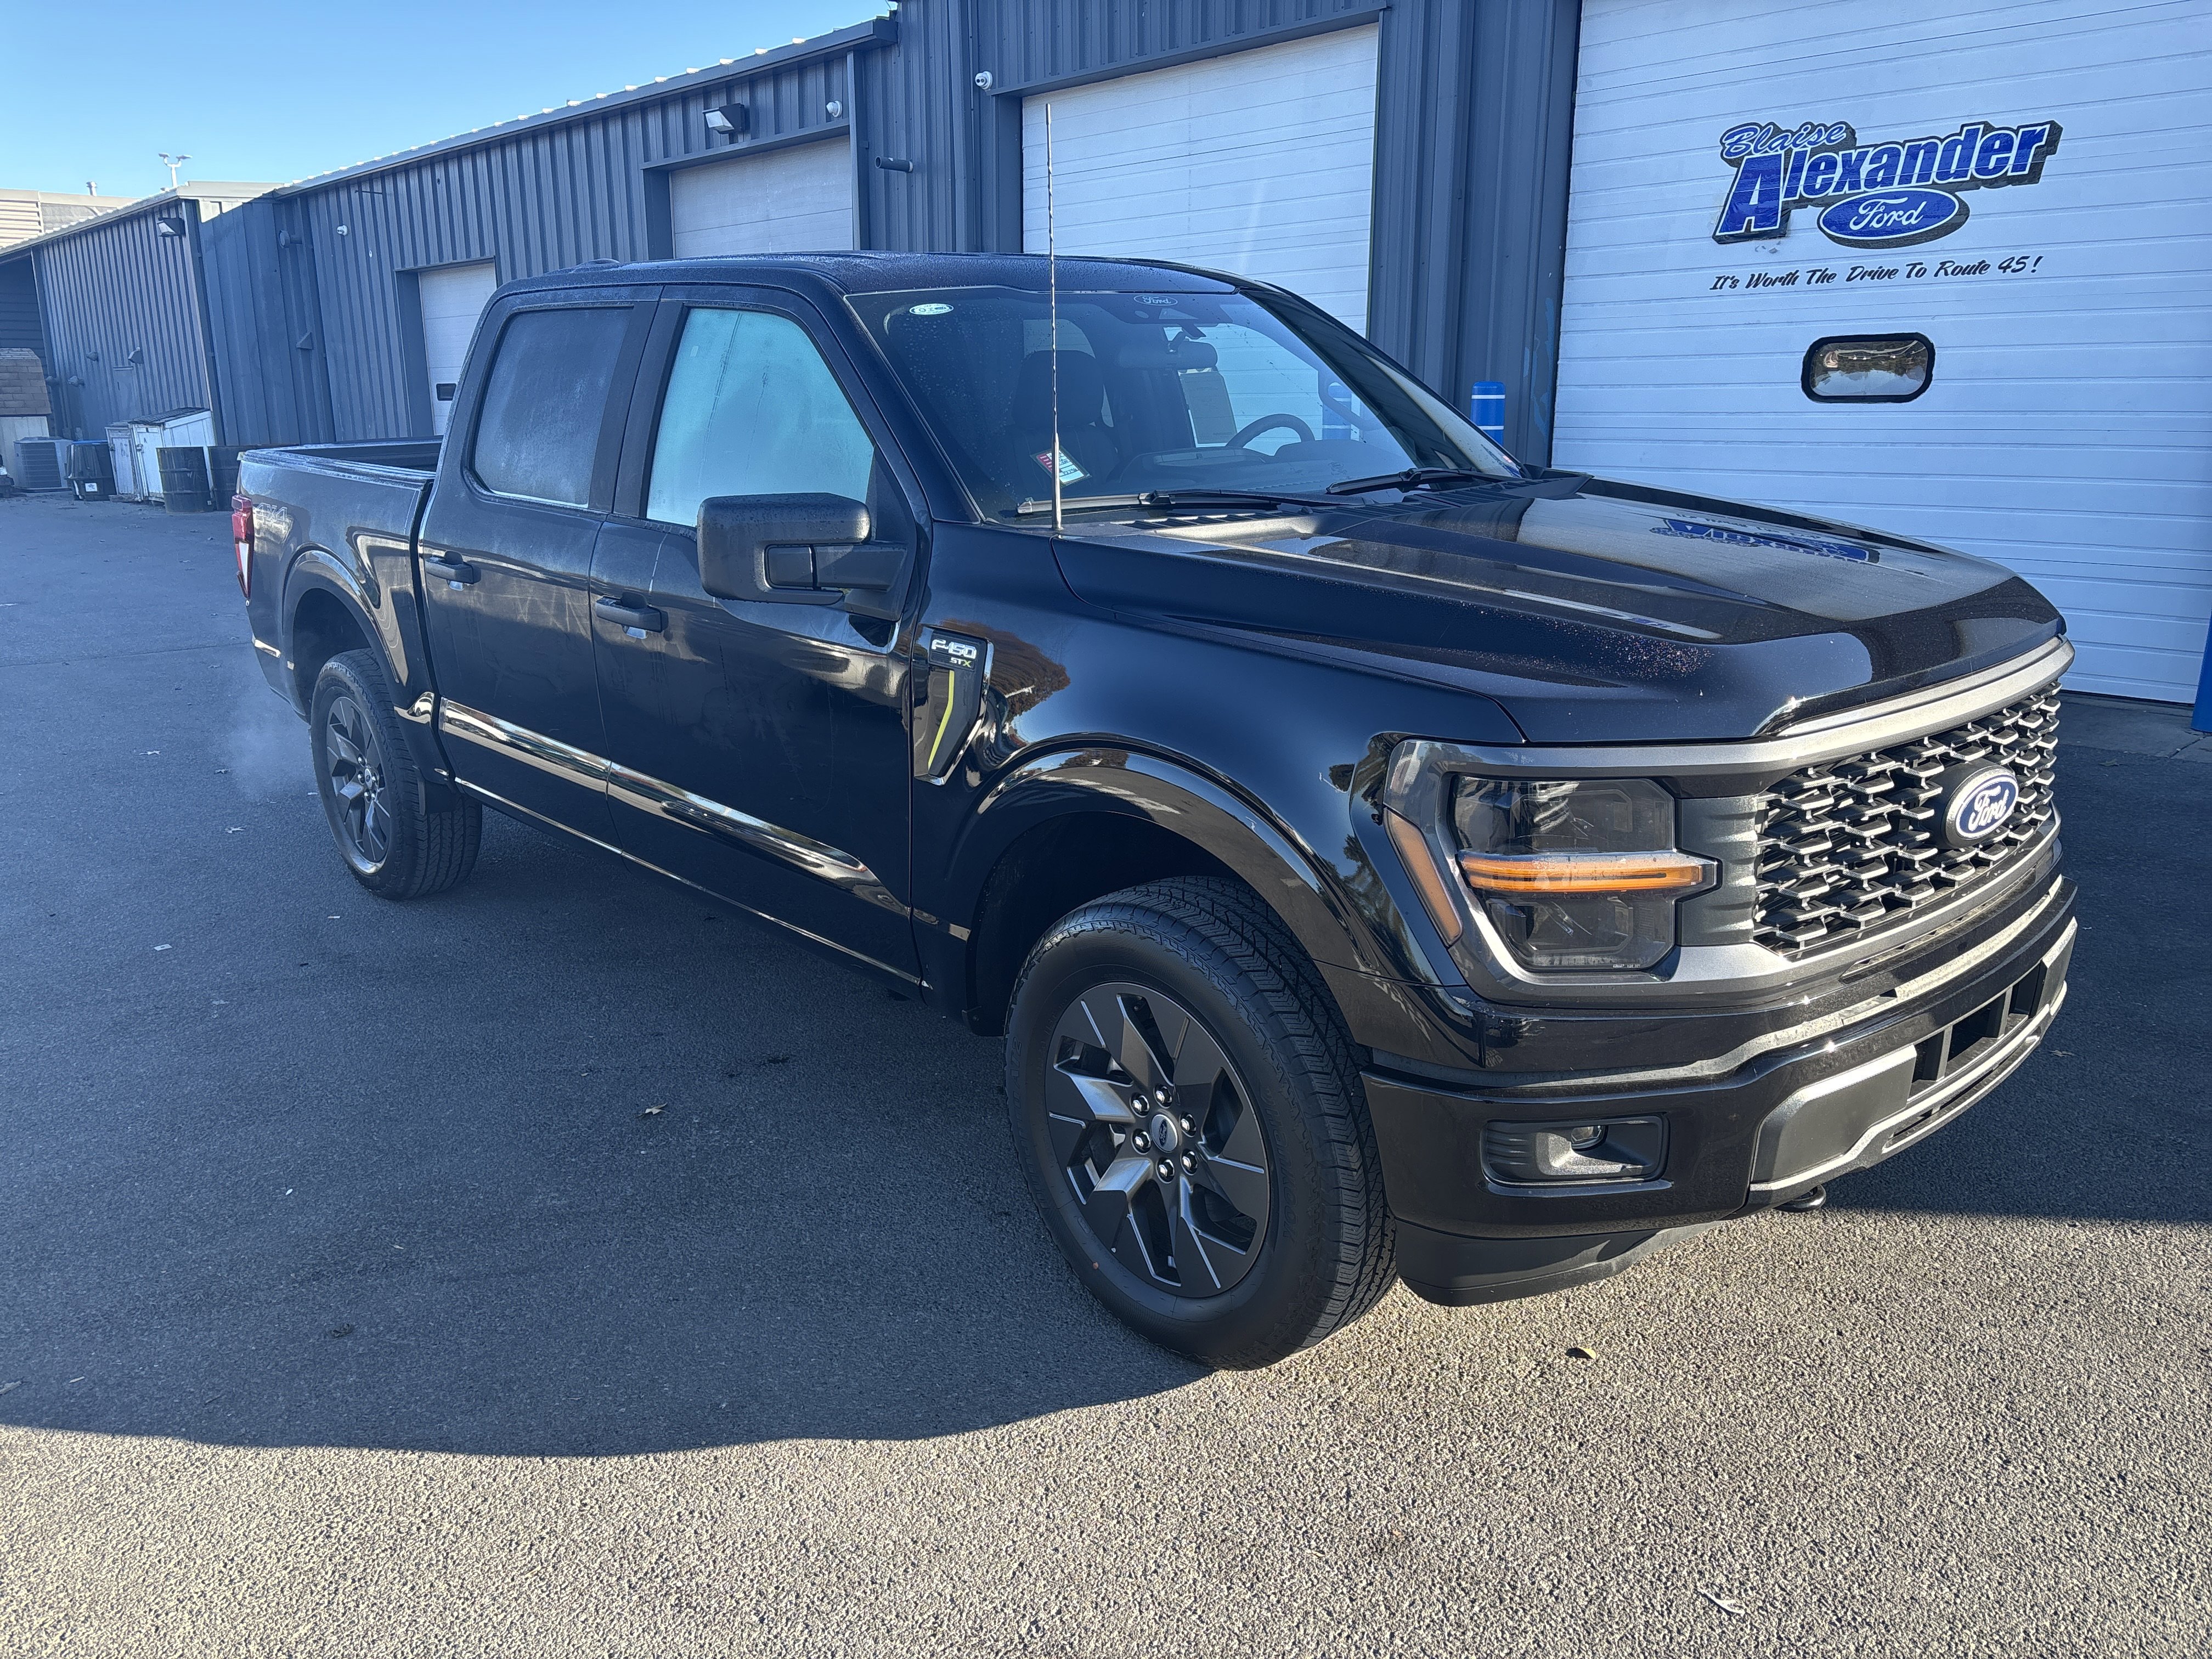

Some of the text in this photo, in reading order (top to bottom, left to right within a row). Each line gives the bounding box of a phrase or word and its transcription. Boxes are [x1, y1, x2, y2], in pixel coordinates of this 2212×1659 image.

[1722, 123, 1848, 160] Blaise
[1714, 122, 2052, 237] Alexander
[1849, 196, 1927, 230] Ford
[1708, 274, 1740, 291] It's
[1745, 269, 1800, 289] Worth
[1805, 267, 1838, 285] The
[1845, 265, 1900, 283] Drive
[1905, 261, 1928, 279] To
[1933, 259, 1991, 278] Route
[1142, 296, 1172, 304] Ford
[931, 639, 977, 659] F-150
[949, 657, 972, 668] STX
[1968, 785, 2010, 832] Ford
